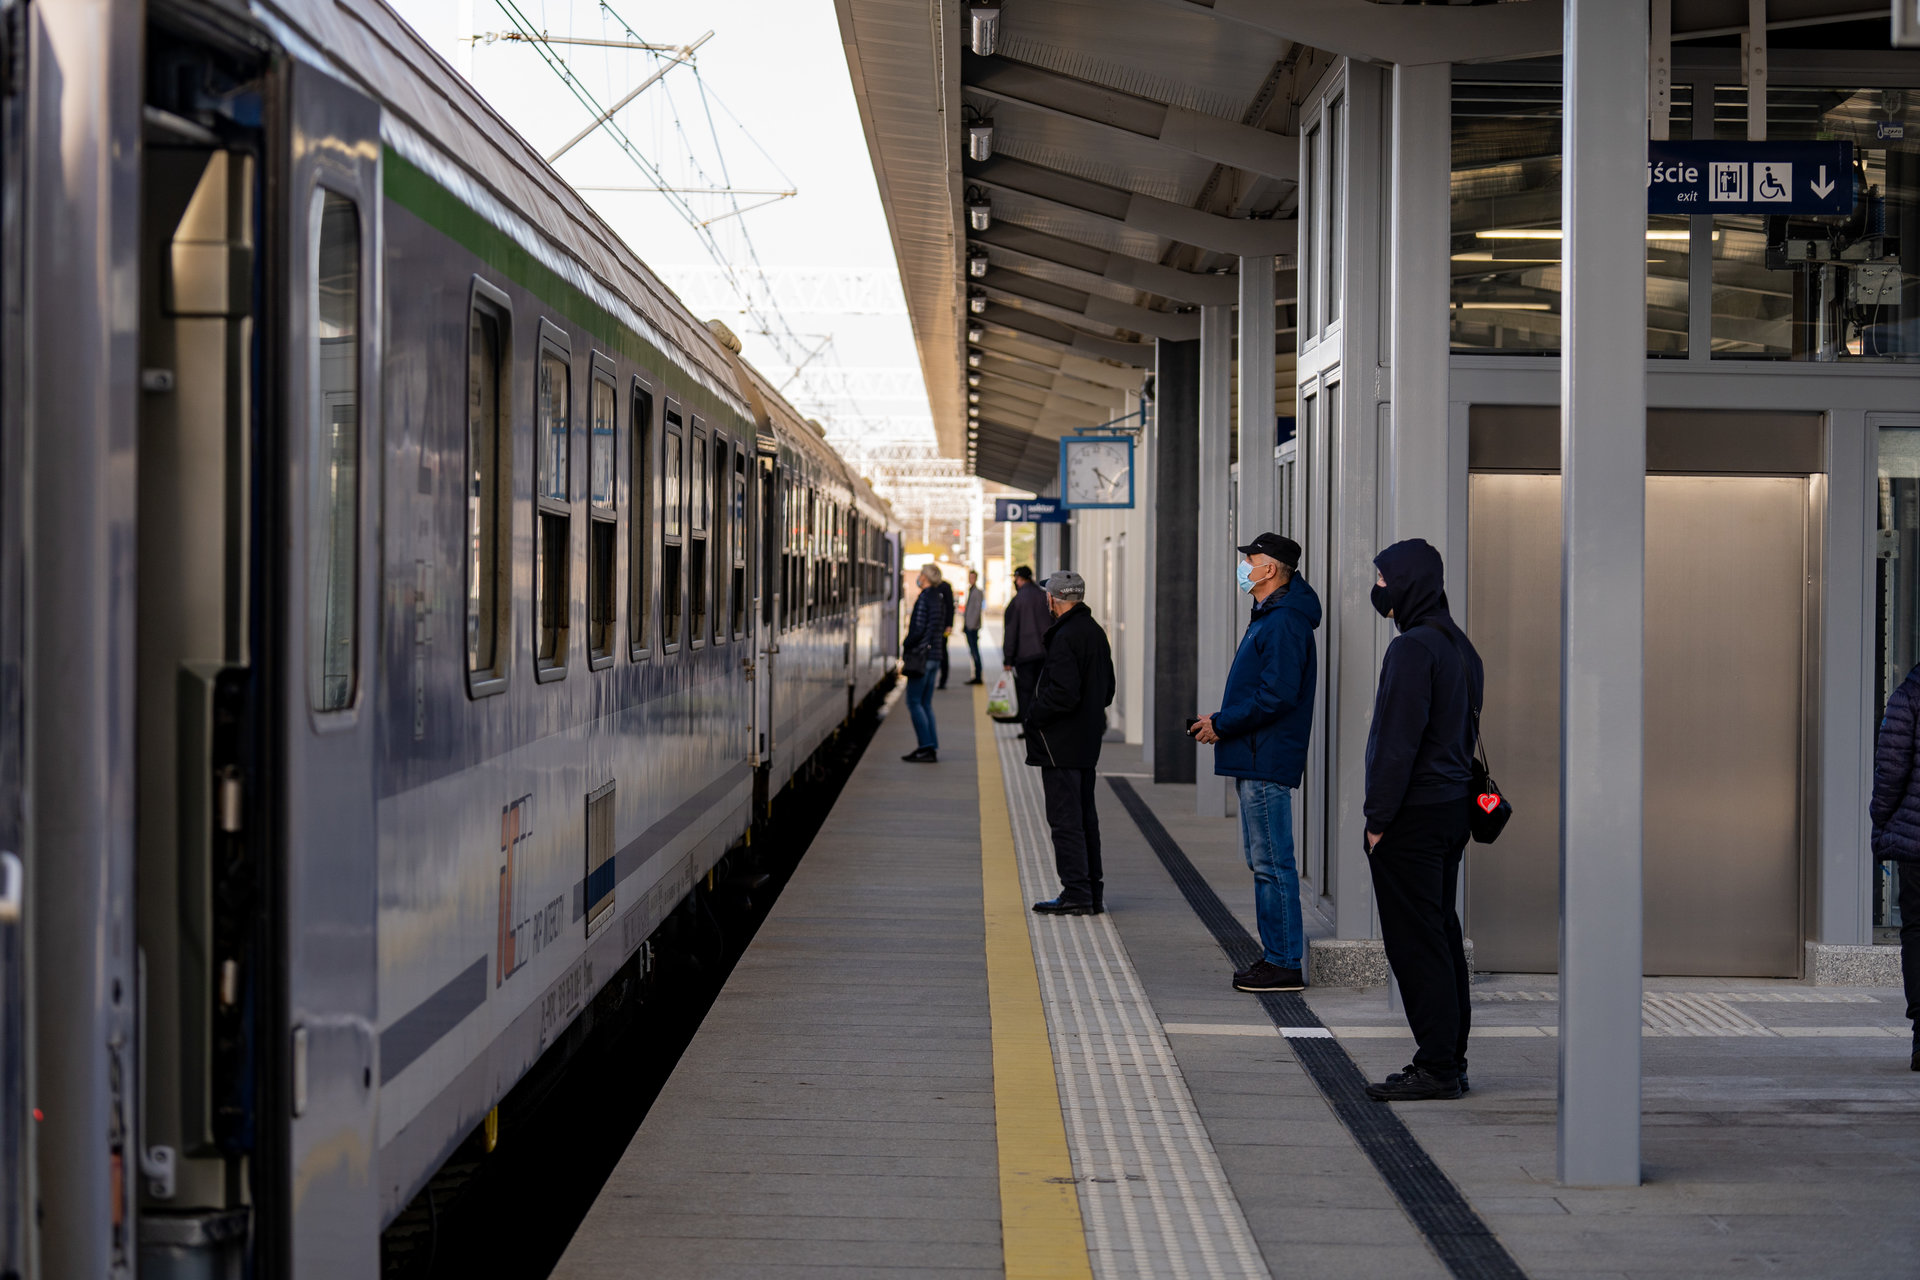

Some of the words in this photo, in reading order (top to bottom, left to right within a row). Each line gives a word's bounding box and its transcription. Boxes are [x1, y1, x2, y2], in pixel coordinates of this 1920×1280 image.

[1646, 161, 1699, 188] jście
[1677, 190, 1699, 202] exit
[1007, 503, 1022, 520] D
